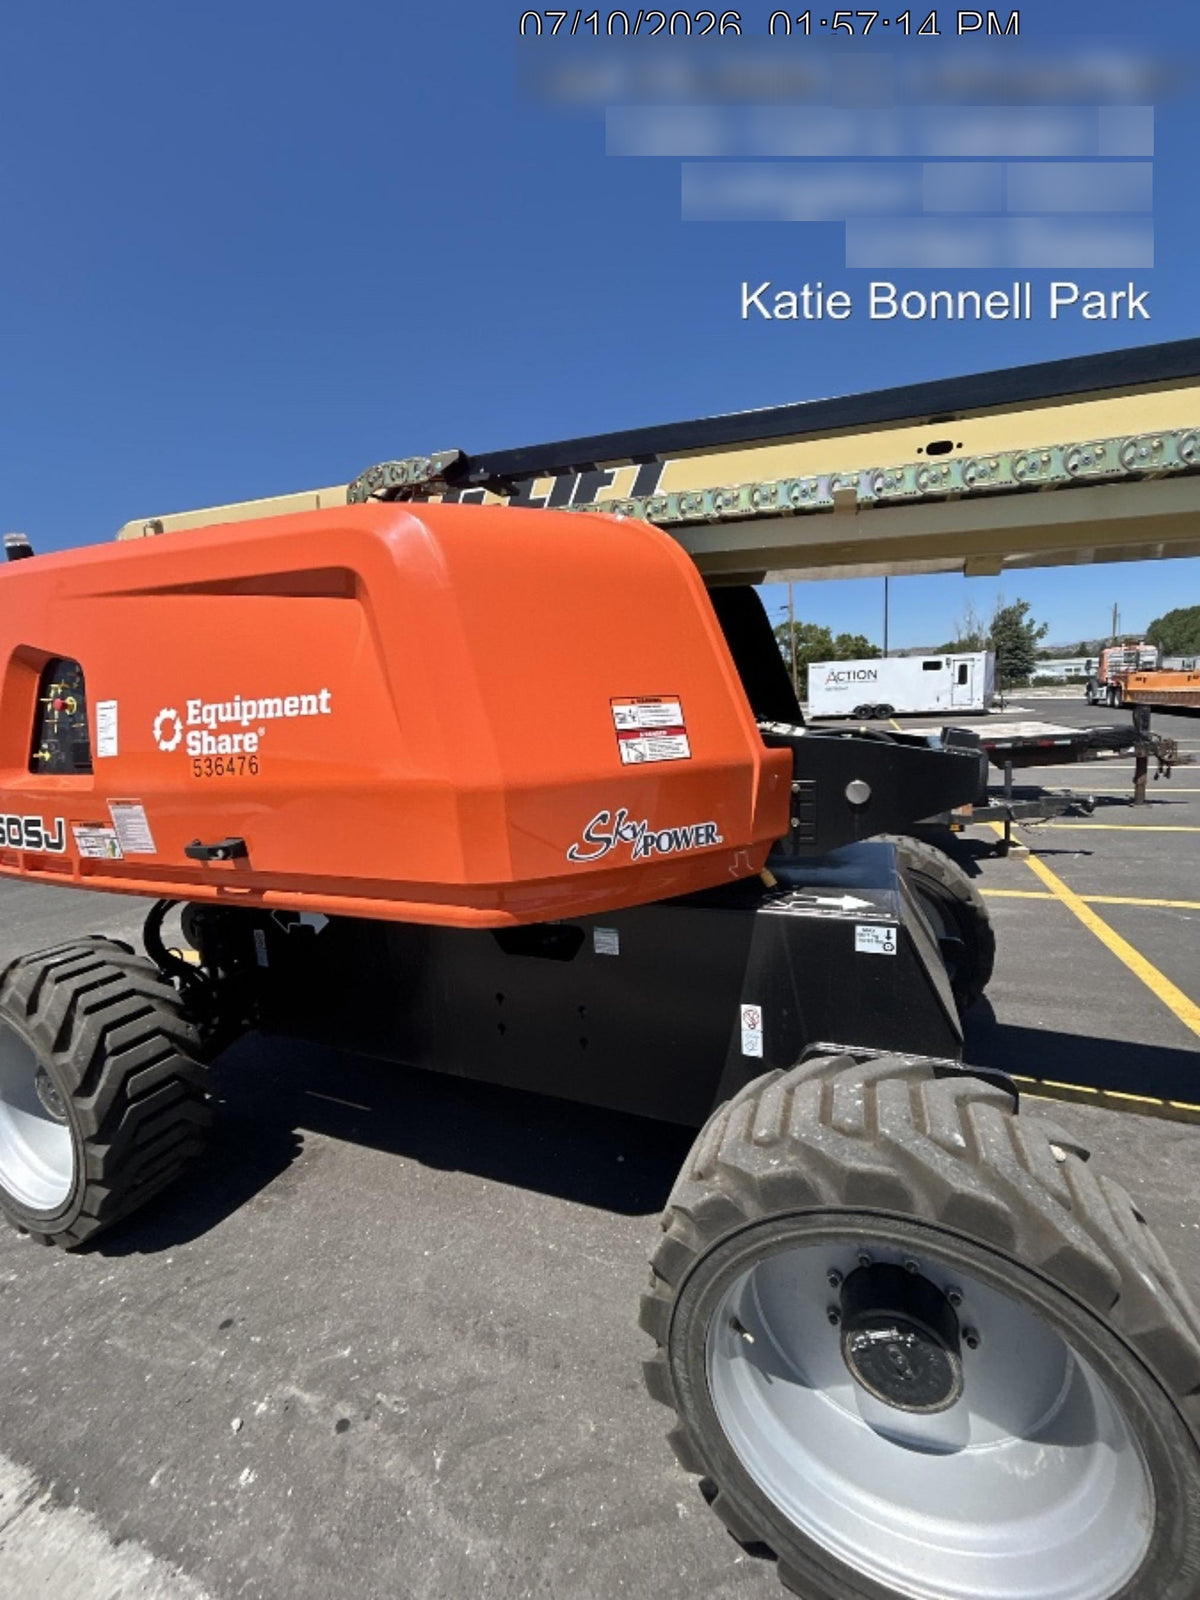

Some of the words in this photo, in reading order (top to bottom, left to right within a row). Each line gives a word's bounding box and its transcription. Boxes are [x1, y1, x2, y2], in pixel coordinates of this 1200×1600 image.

[825, 669, 878, 685] ACTION
[186, 688, 332, 729] Equipment
[192, 755, 259, 778] 536476
